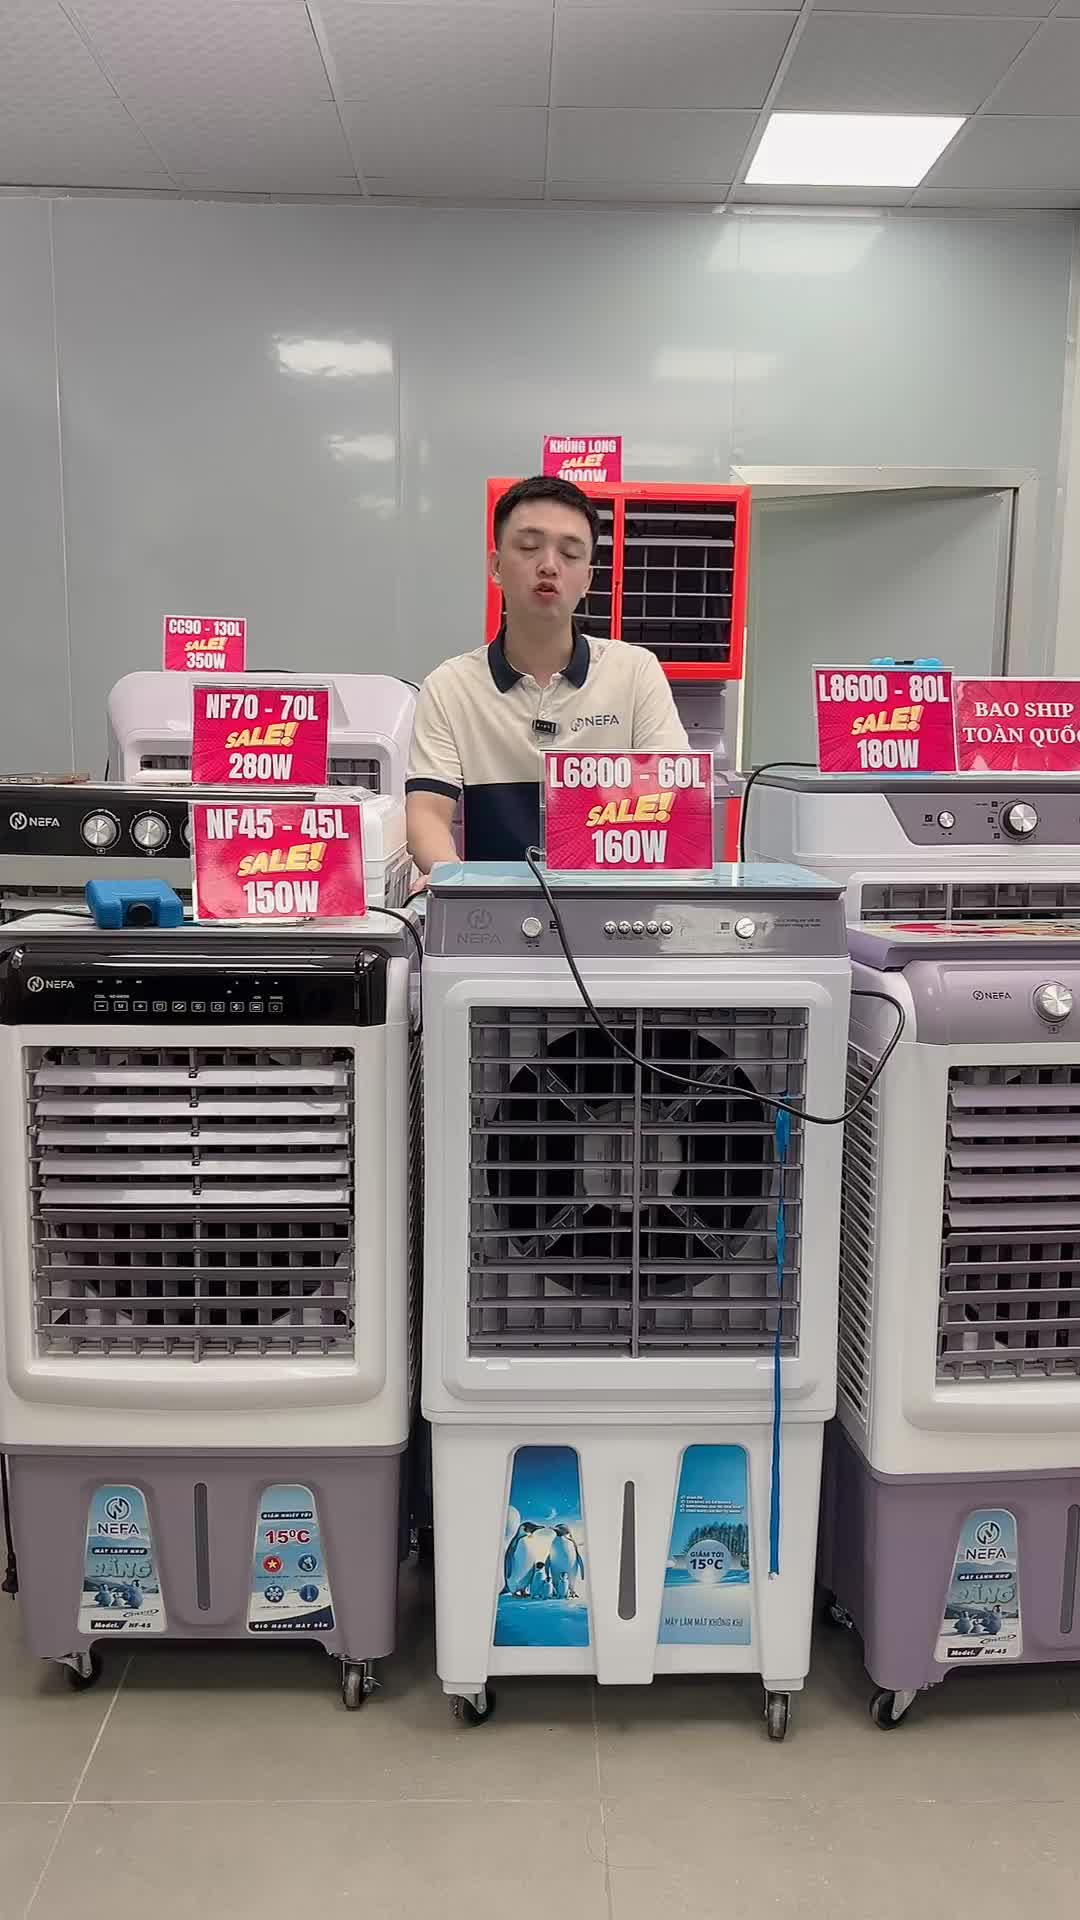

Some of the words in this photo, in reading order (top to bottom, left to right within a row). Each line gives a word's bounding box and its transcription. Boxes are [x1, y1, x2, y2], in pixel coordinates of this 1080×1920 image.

[588, 440, 617, 454] LONG
[561, 453, 605, 469] SALE!
[169, 619, 202, 635] CC90
[214, 621, 242, 637] 130L
[184, 636, 228, 652] SALE!
[186, 652, 226, 669] 350W
[819, 674, 888, 702] L8600
[909, 675, 950, 703] 80L
[206, 693, 259, 720] NF70
[280, 694, 319, 721] 70L
[974, 702, 1019, 717] BAO
[1024, 702, 1075, 718] SHIP
[584, 714, 620, 727] NEFA
[851, 704, 924, 735] SALE!
[225, 721, 300, 749] SALE!
[962, 724, 1024, 743] TOÀN
[1029, 723, 1080, 748] QUỐ
[857, 738, 920, 769] 180W
[229, 752, 293, 780] 280W
[550, 756, 632, 789] L6800
[658, 757, 706, 789] 60L
[585, 791, 677, 827] SALE!
[29, 817, 60, 828] NEFA
[206, 808, 274, 840] NF45
[301, 808, 349, 840] 45L
[591, 829, 667, 864] 160W
[237, 841, 328, 877] SALE!
[243, 880, 320, 914] 150W
[457, 933, 503, 944] NEFA
[45, 980, 75, 989] NEFA
[985, 992, 1012, 1000] NEFA
[98, 1523, 139, 1535] NEFA
[966, 1548, 1007, 1560] NEFA
